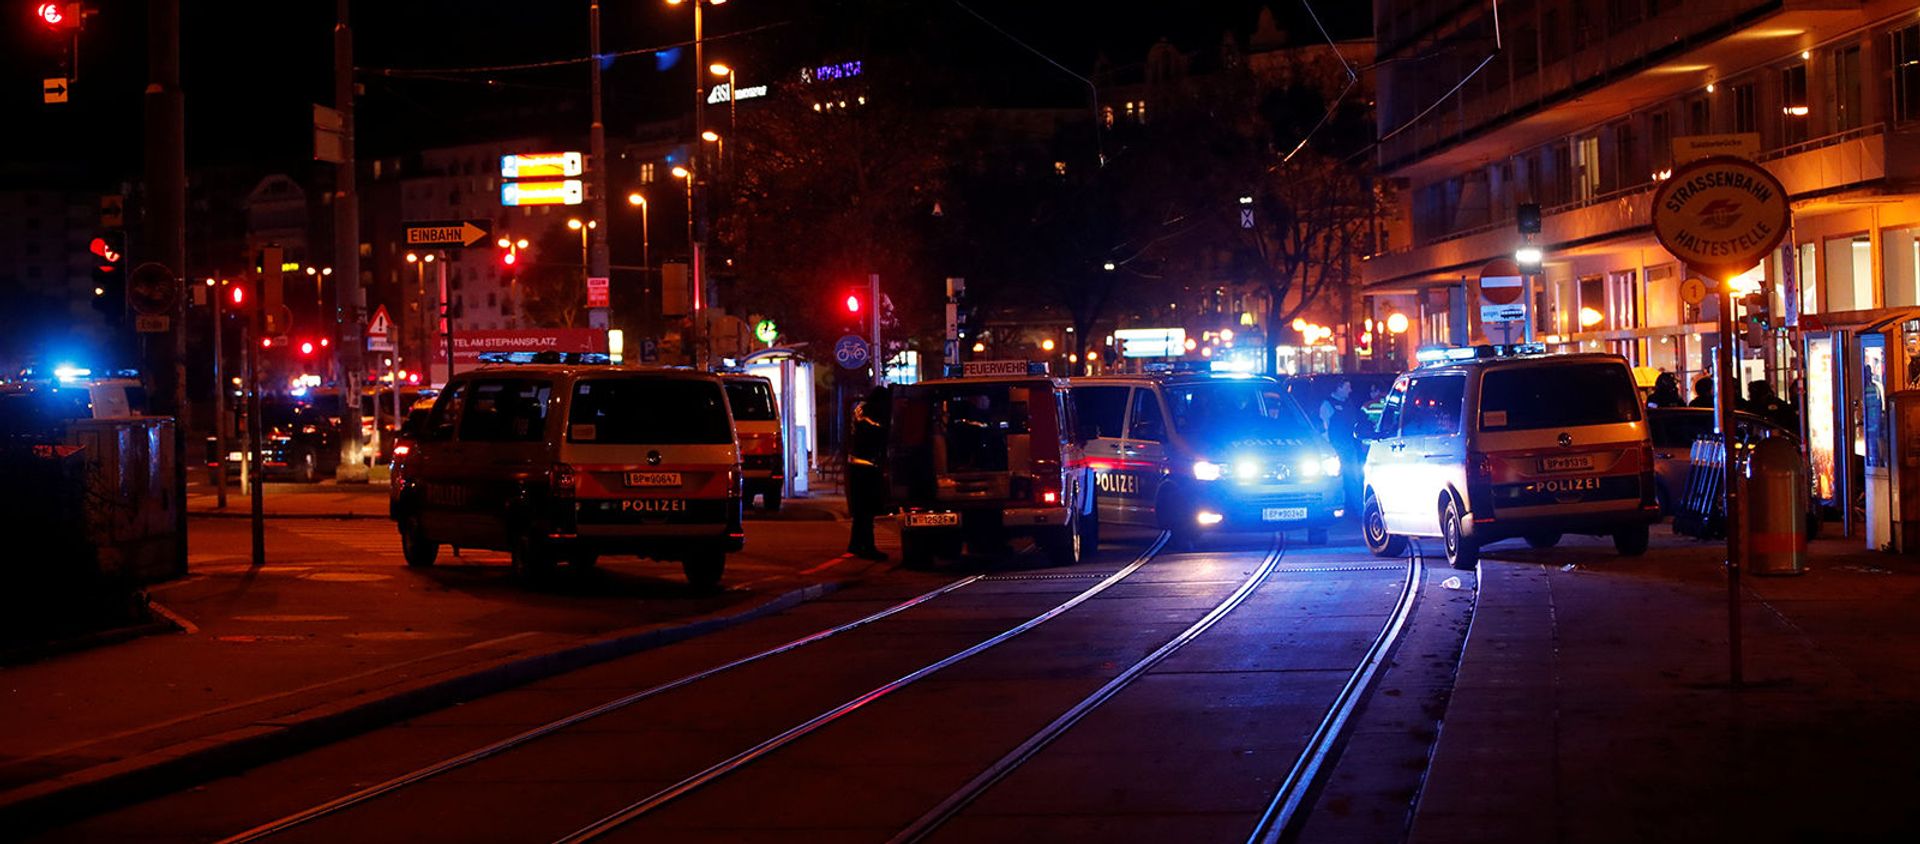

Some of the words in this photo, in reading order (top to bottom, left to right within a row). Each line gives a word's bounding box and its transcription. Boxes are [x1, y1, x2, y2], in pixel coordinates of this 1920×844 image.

[1666, 171, 1773, 213] STRASSENBAHN
[411, 228, 462, 242] EINBAHN
[1675, 221, 1772, 257] HALTESTELLE
[1690, 286, 1698, 298] 1
[440, 338, 471, 348] HTEL
[471, 338, 484, 348] AM
[485, 336, 557, 348] STEPHANSPLATZ
[964, 361, 1027, 375] FEUERWEHR
[1536, 477, 1601, 493] POLIZEI
[622, 500, 687, 511] POLIZEI
